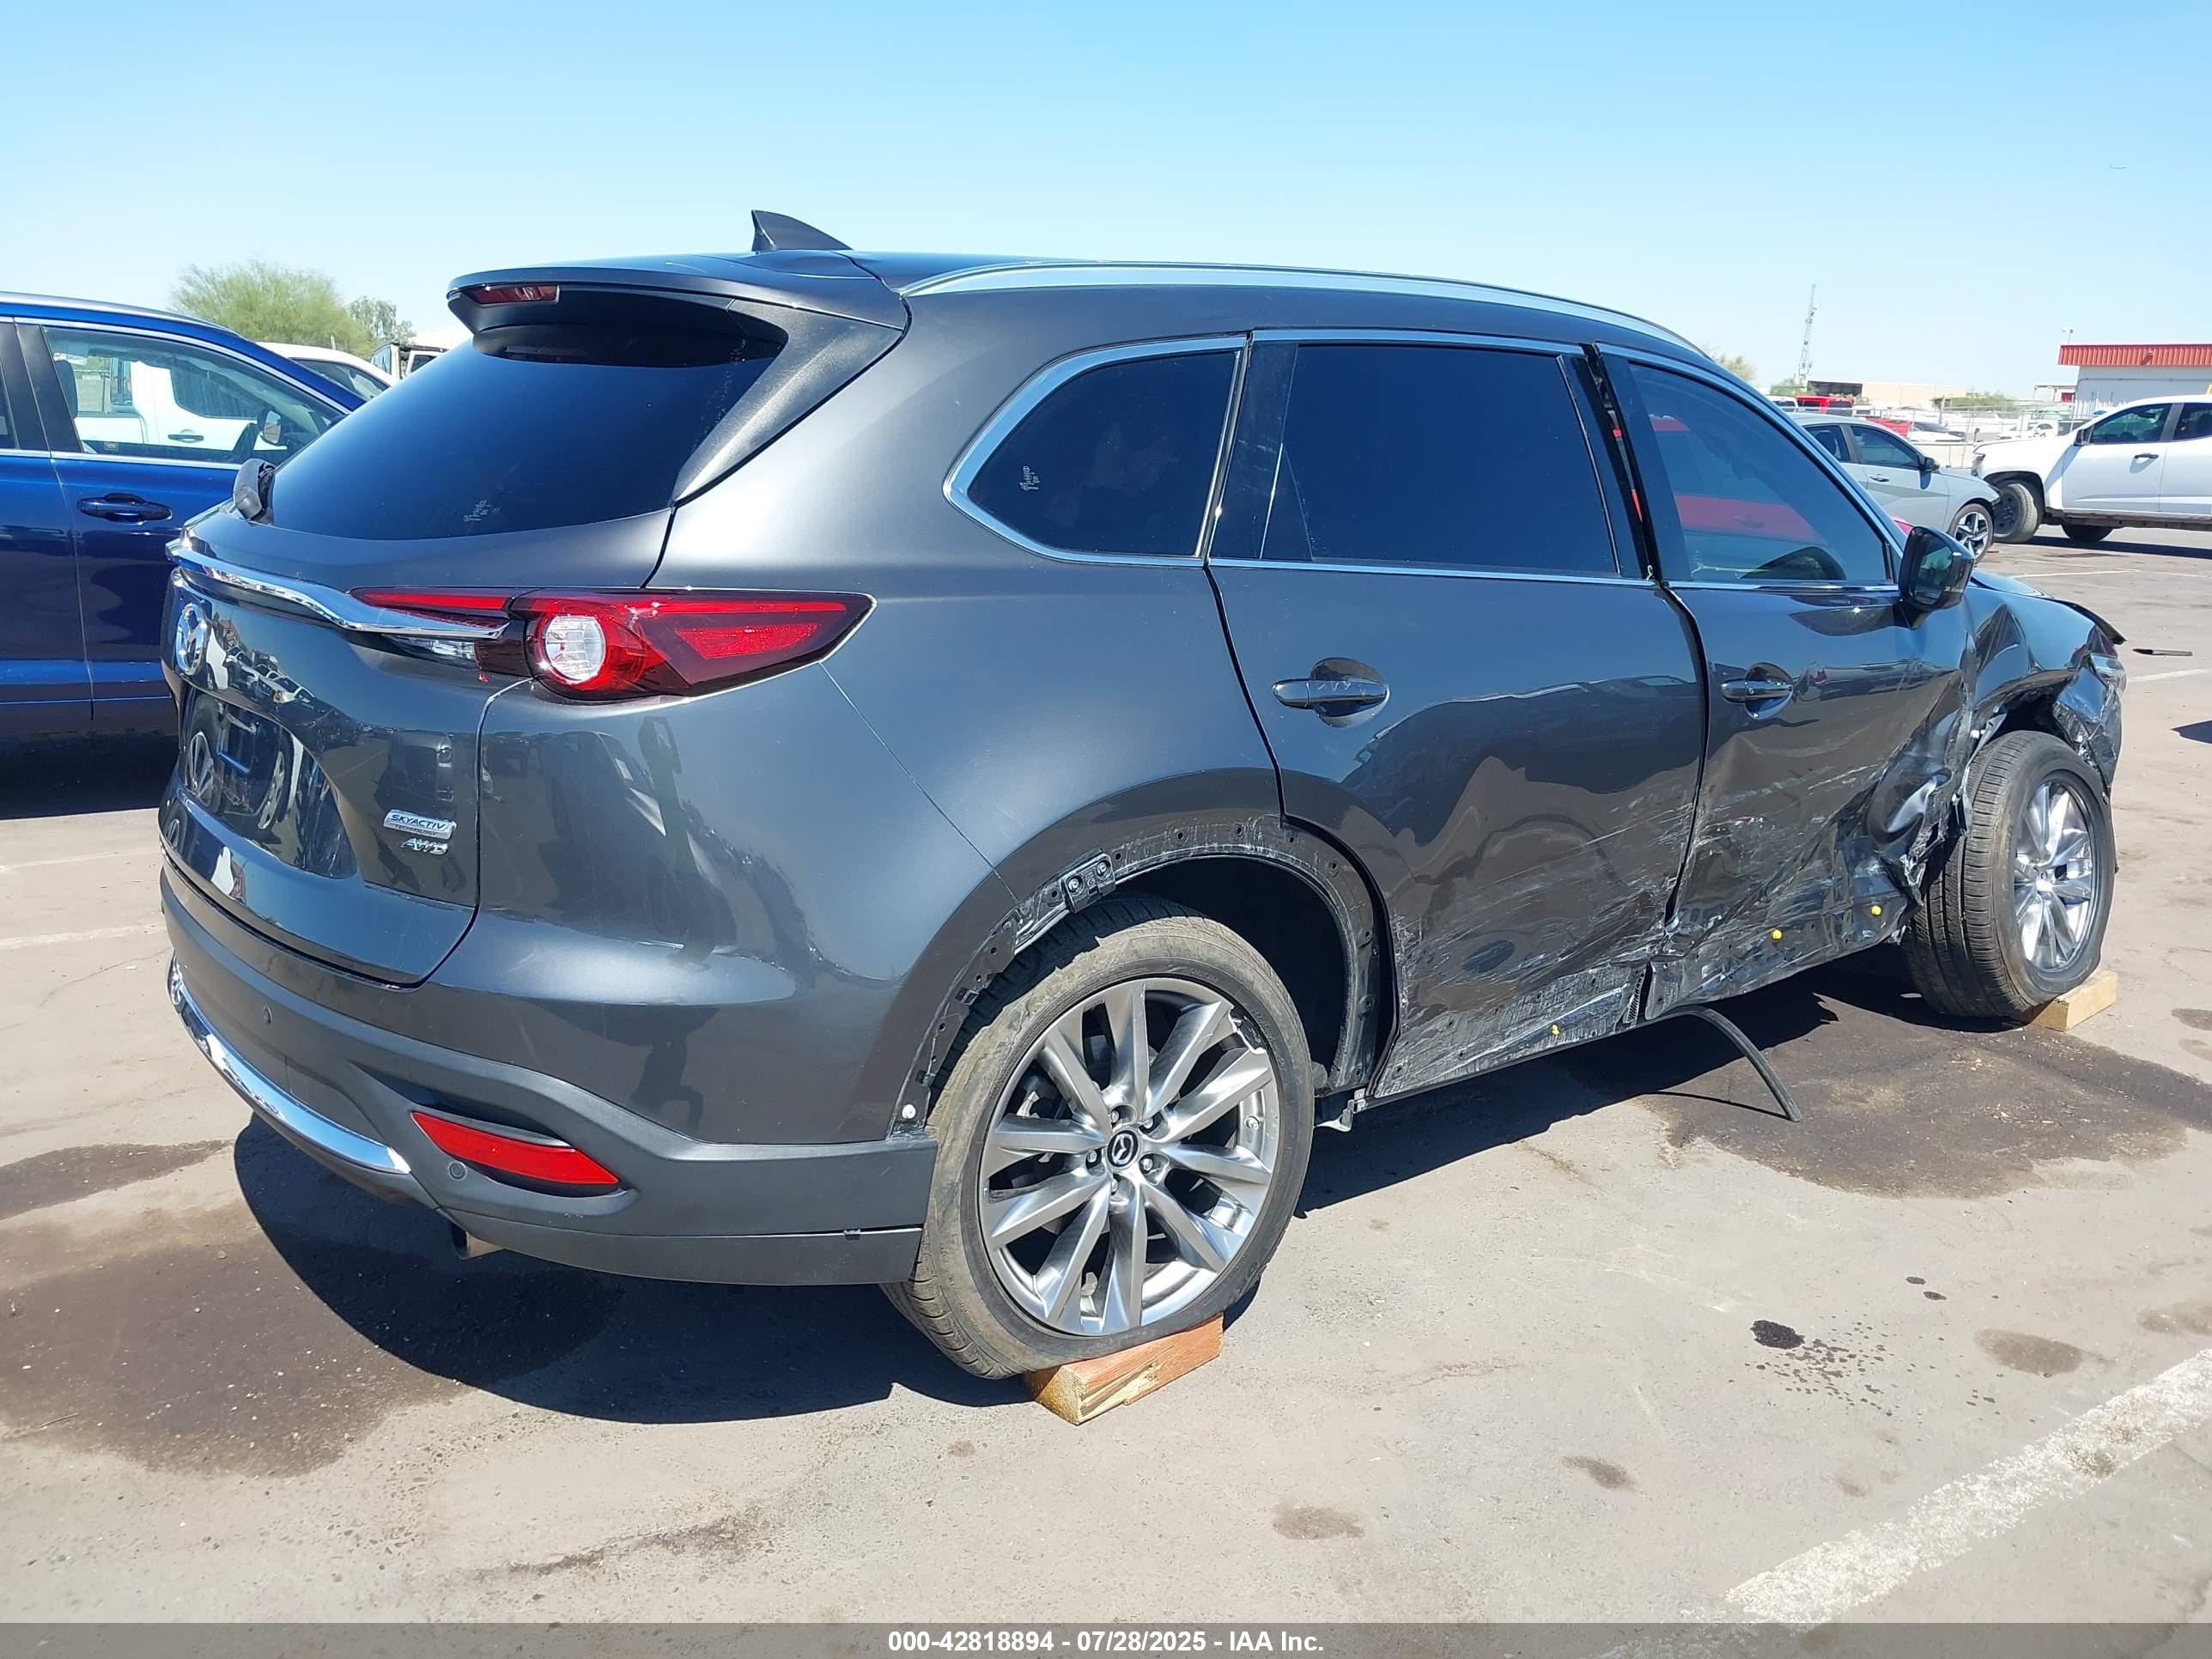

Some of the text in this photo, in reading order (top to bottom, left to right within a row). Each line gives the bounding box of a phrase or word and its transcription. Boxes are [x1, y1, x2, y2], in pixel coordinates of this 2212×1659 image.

[391, 814, 447, 830] SKYACTIV
[394, 823, 438, 836] TECHNOLOGY
[400, 837, 448, 855] AWD
